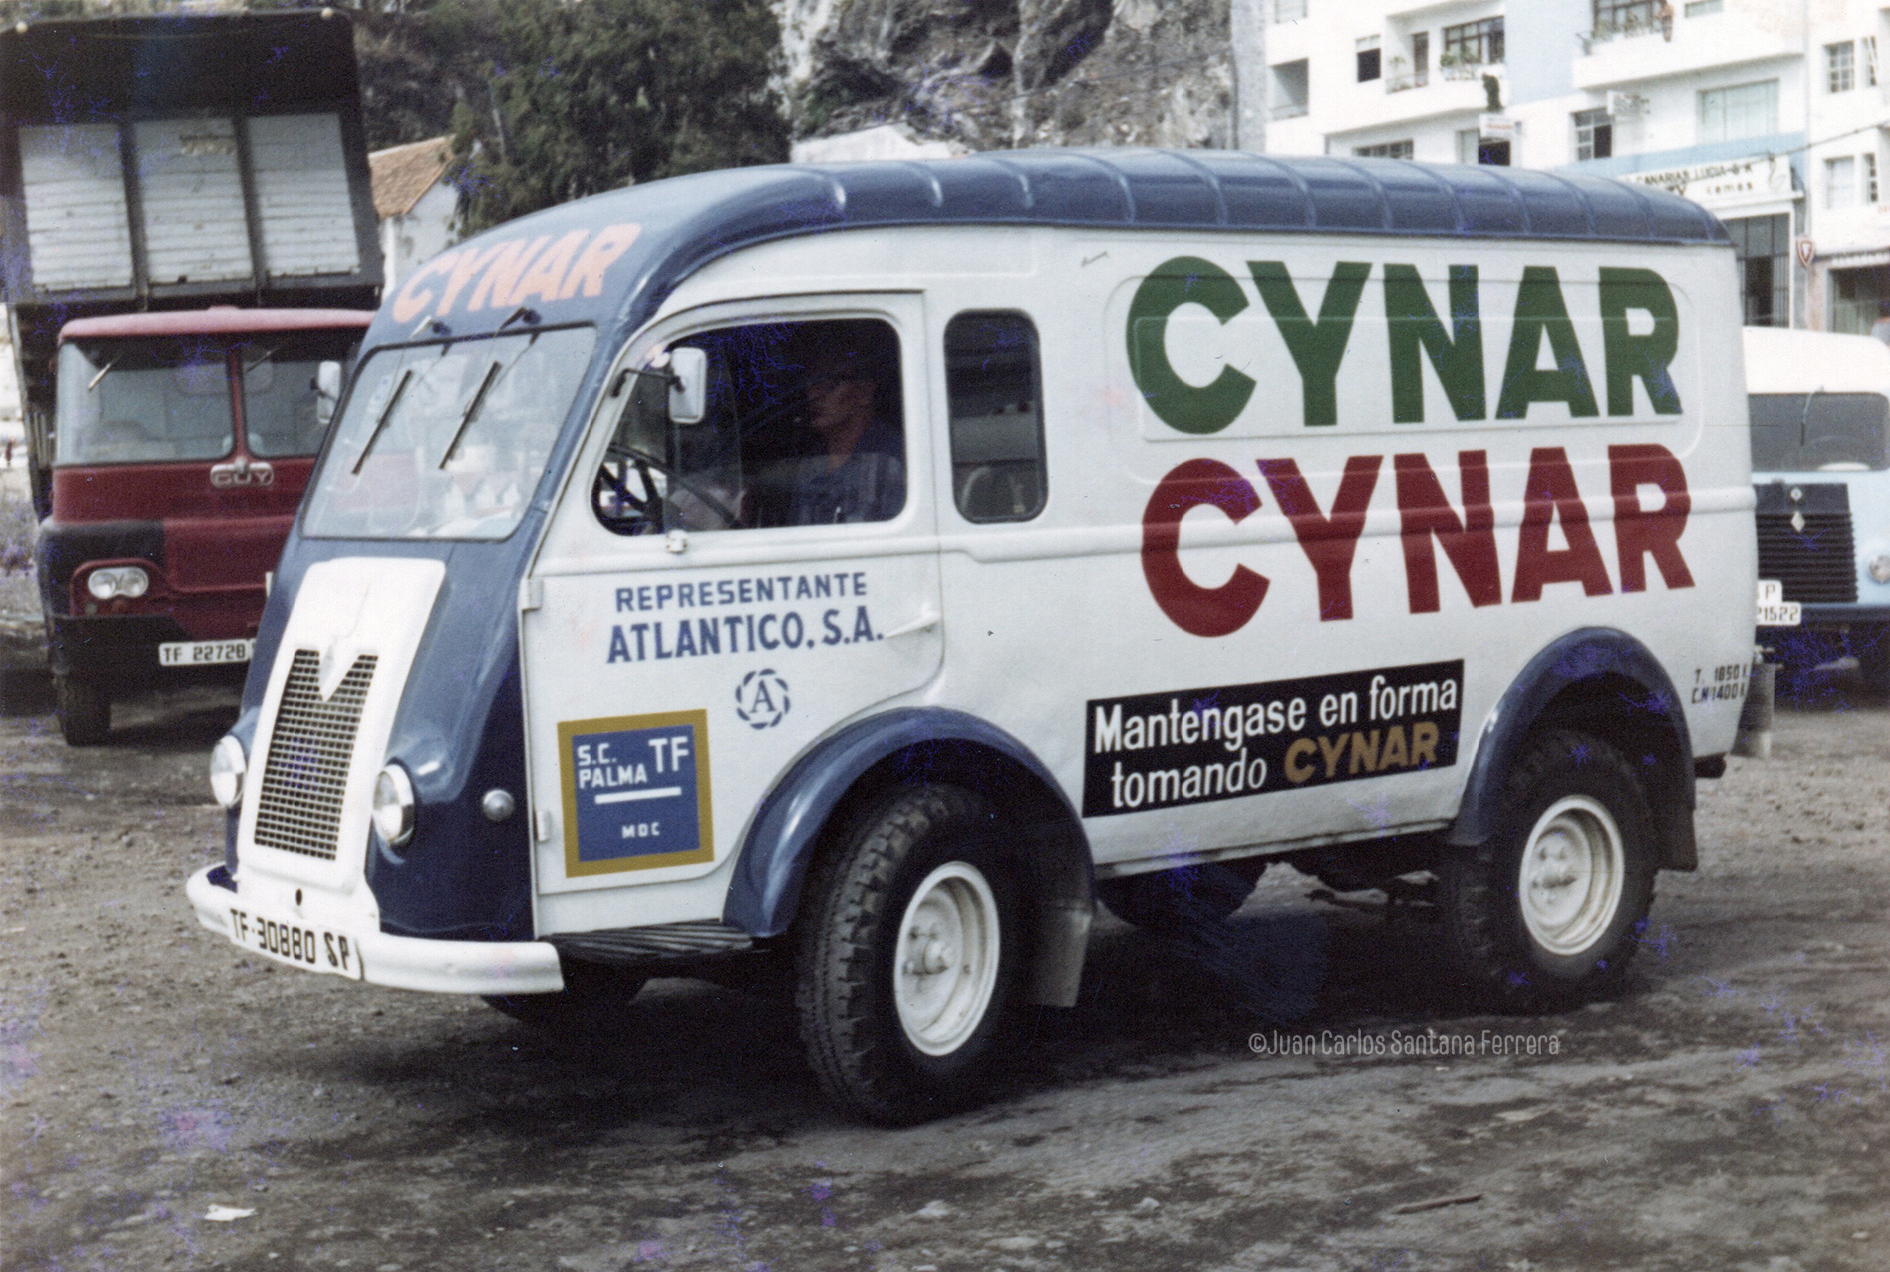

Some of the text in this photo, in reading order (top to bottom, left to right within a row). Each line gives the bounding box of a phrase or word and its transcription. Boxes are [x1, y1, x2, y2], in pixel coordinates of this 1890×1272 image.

[392, 223, 641, 324] CYNAR
[1126, 256, 1683, 434] CYNAR
[1141, 443, 1696, 638] CYNAR
[614, 572, 868, 613] REPRESENTANTE
[163, 647, 182, 663] TF
[1095, 675, 1457, 753] Mantengase en forma
[577, 743, 617, 766] S.C.
[648, 736, 690, 773] TF
[1111, 721, 1440, 808] tomando CYNAR
[578, 763, 648, 789] PALMA
[324, 932, 350, 970] SP
